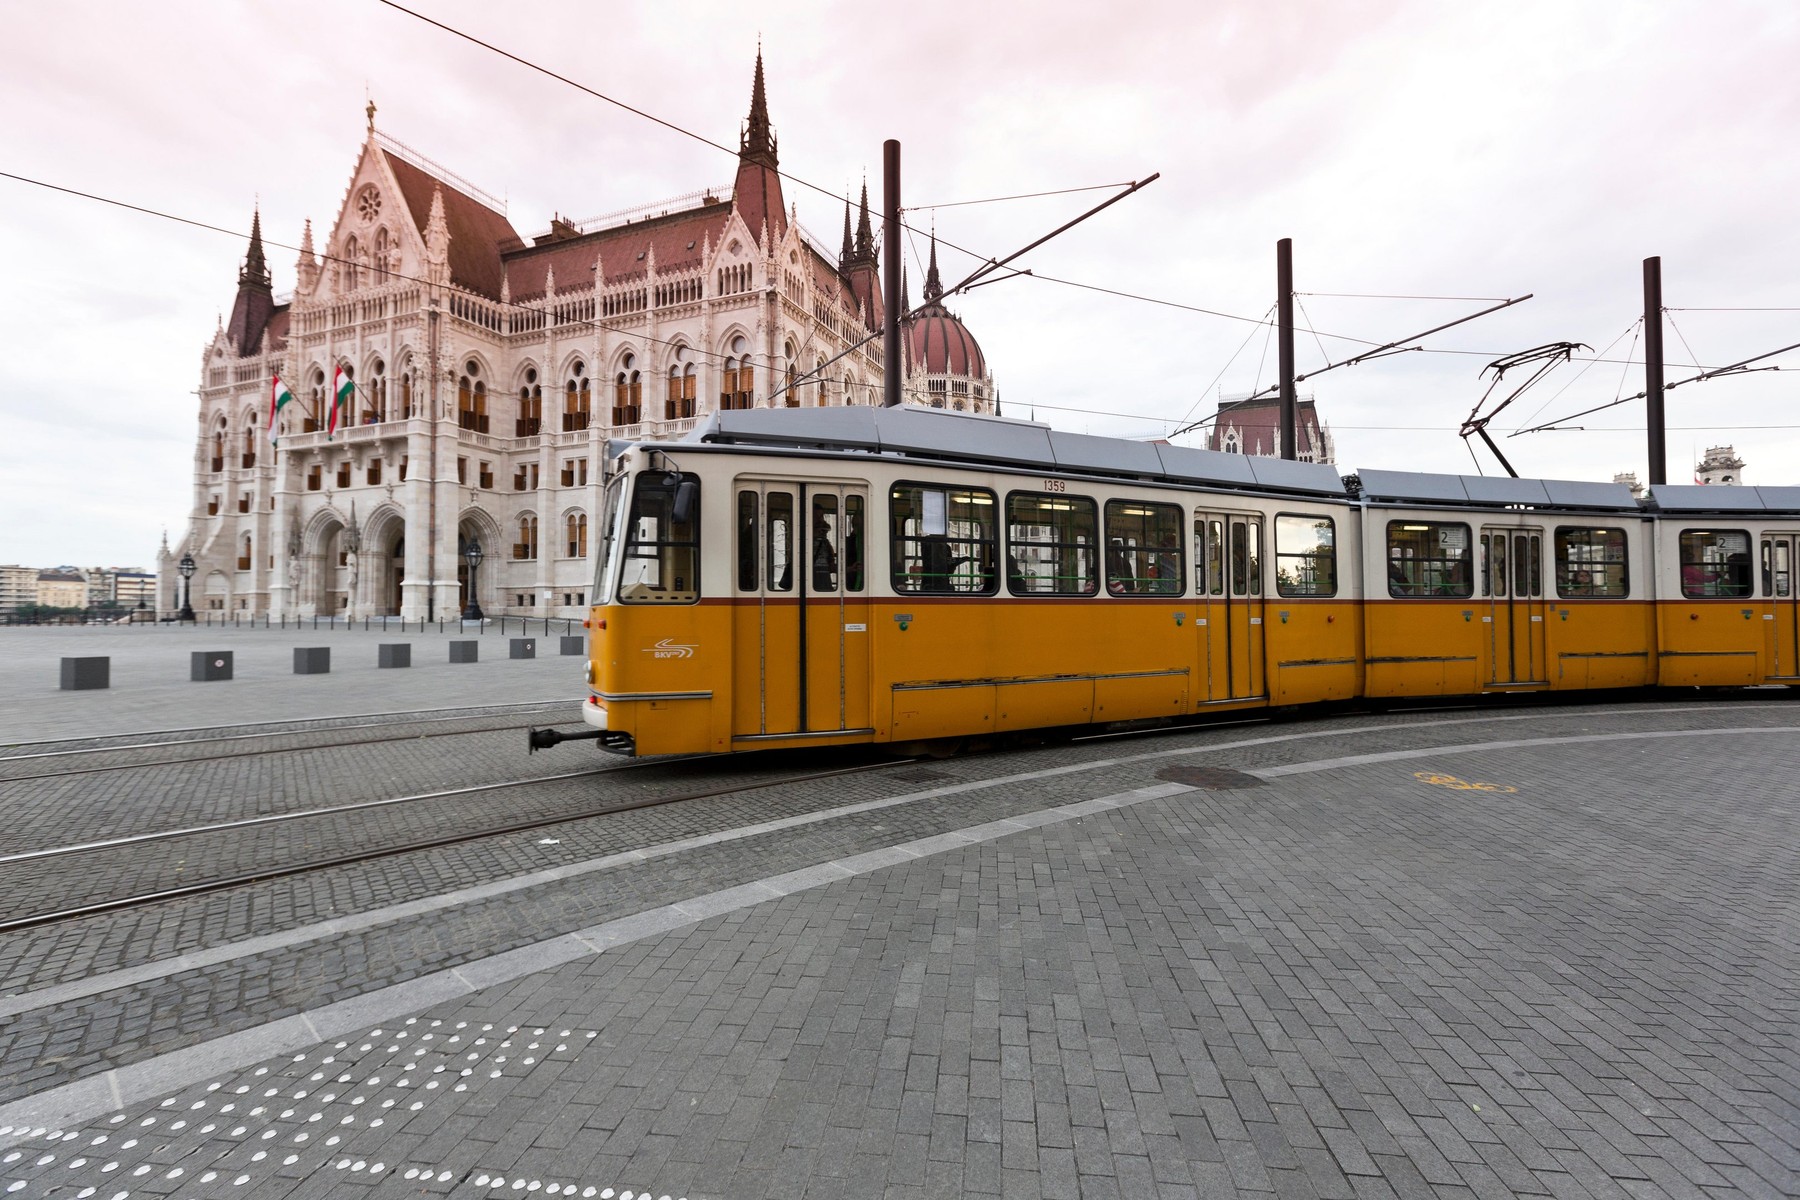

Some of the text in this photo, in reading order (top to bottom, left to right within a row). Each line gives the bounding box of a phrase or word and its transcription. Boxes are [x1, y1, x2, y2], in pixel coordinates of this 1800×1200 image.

[1044, 480, 1065, 492] 1359
[1441, 531, 1448, 543] 2
[1718, 537, 1726, 548] 2
